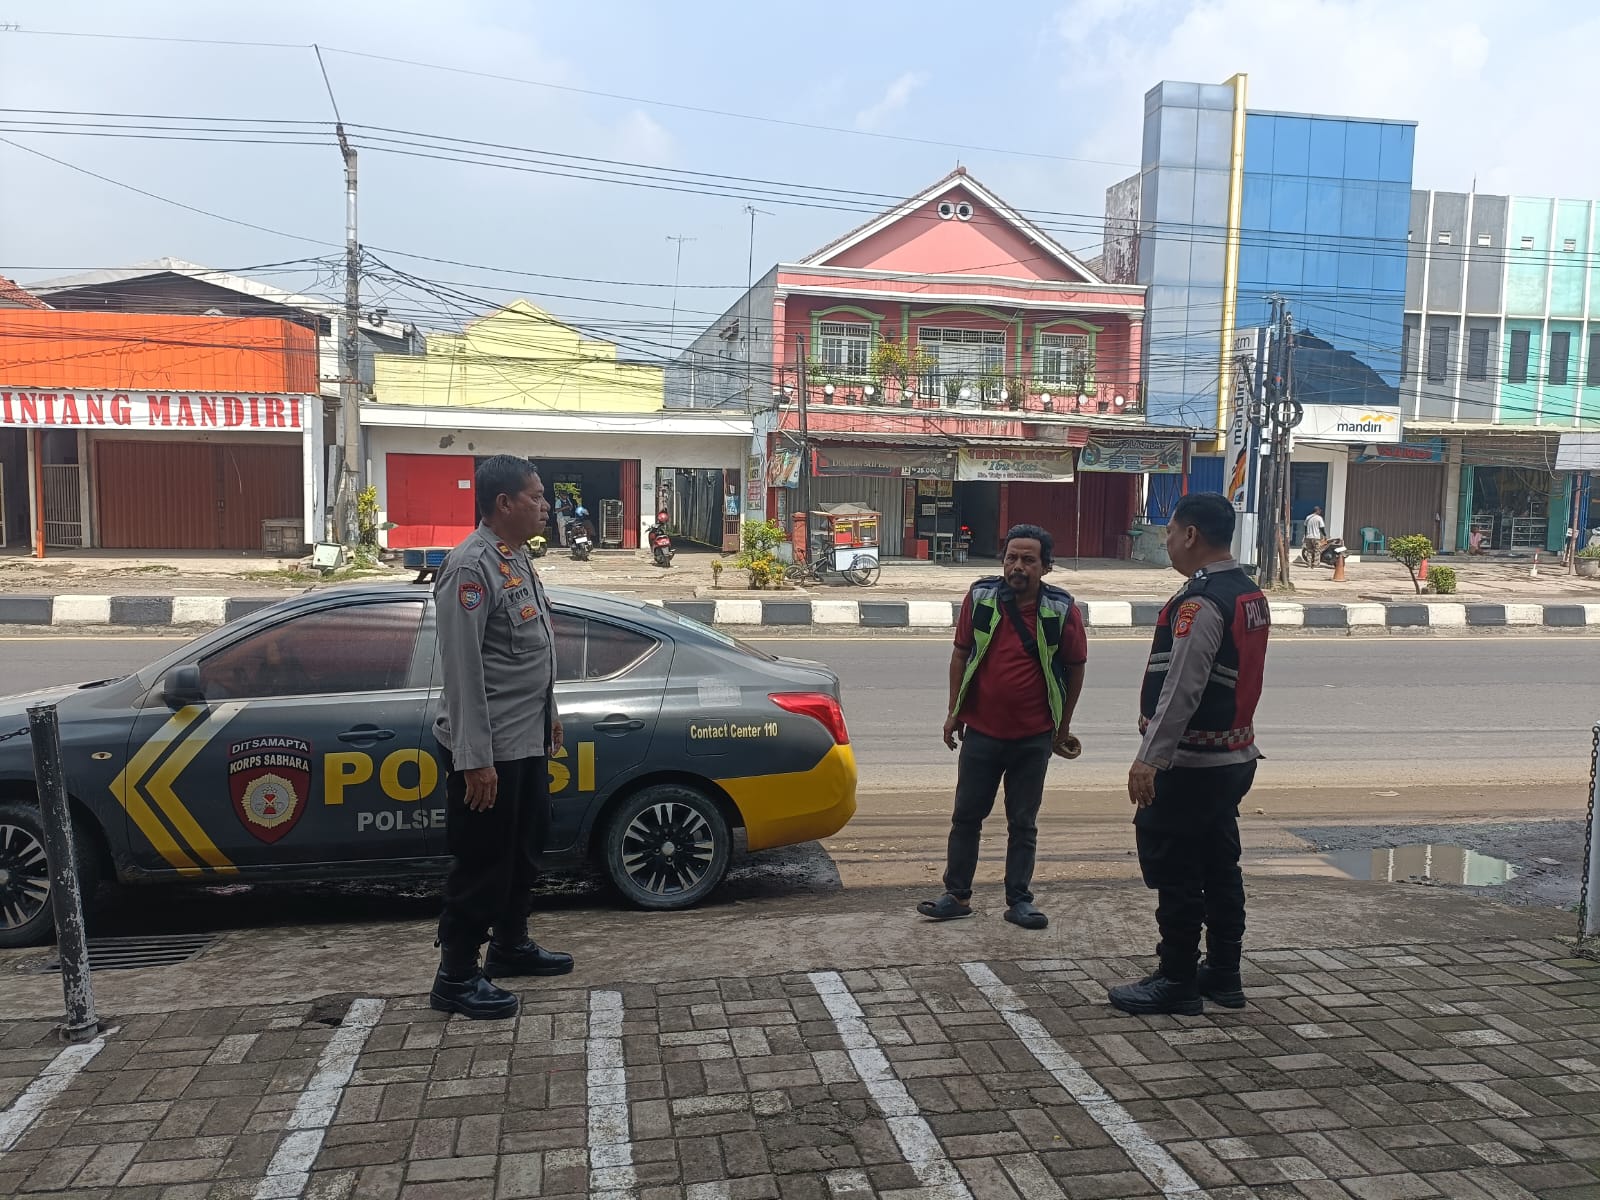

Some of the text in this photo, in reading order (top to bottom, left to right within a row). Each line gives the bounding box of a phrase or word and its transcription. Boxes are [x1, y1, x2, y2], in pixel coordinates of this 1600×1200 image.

[147, 395, 302, 428] MANDIRI
[1234, 380, 1247, 446] mandiri
[1337, 421, 1382, 433] mandiri
[690, 722, 778, 739] Contact Center 110
[231, 737, 309, 754] DITSAMAPTA
[230, 754, 310, 774] KORPS SABHARA
